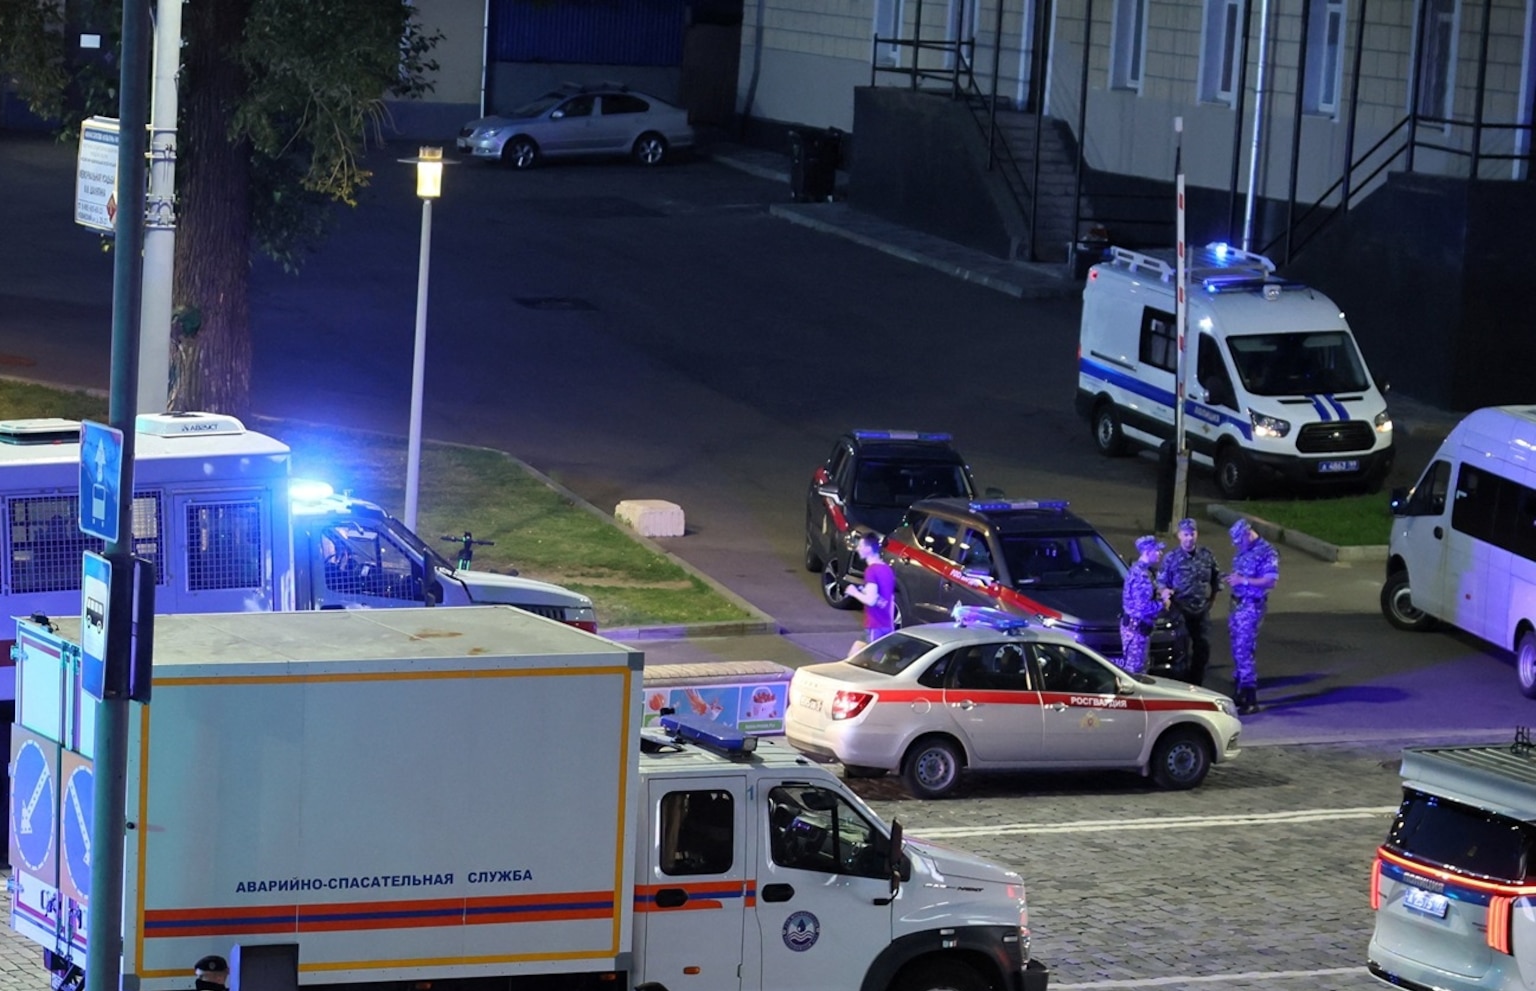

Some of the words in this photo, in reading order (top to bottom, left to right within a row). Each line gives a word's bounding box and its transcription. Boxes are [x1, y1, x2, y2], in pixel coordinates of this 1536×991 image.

[1070, 696, 1127, 708] РОСГВАРДИЯ
[235, 872, 454, 894] АВАРИЙНО-СПАСАТЕЛЬНАЯ
[467, 868, 533, 885] СЛУЖБА
